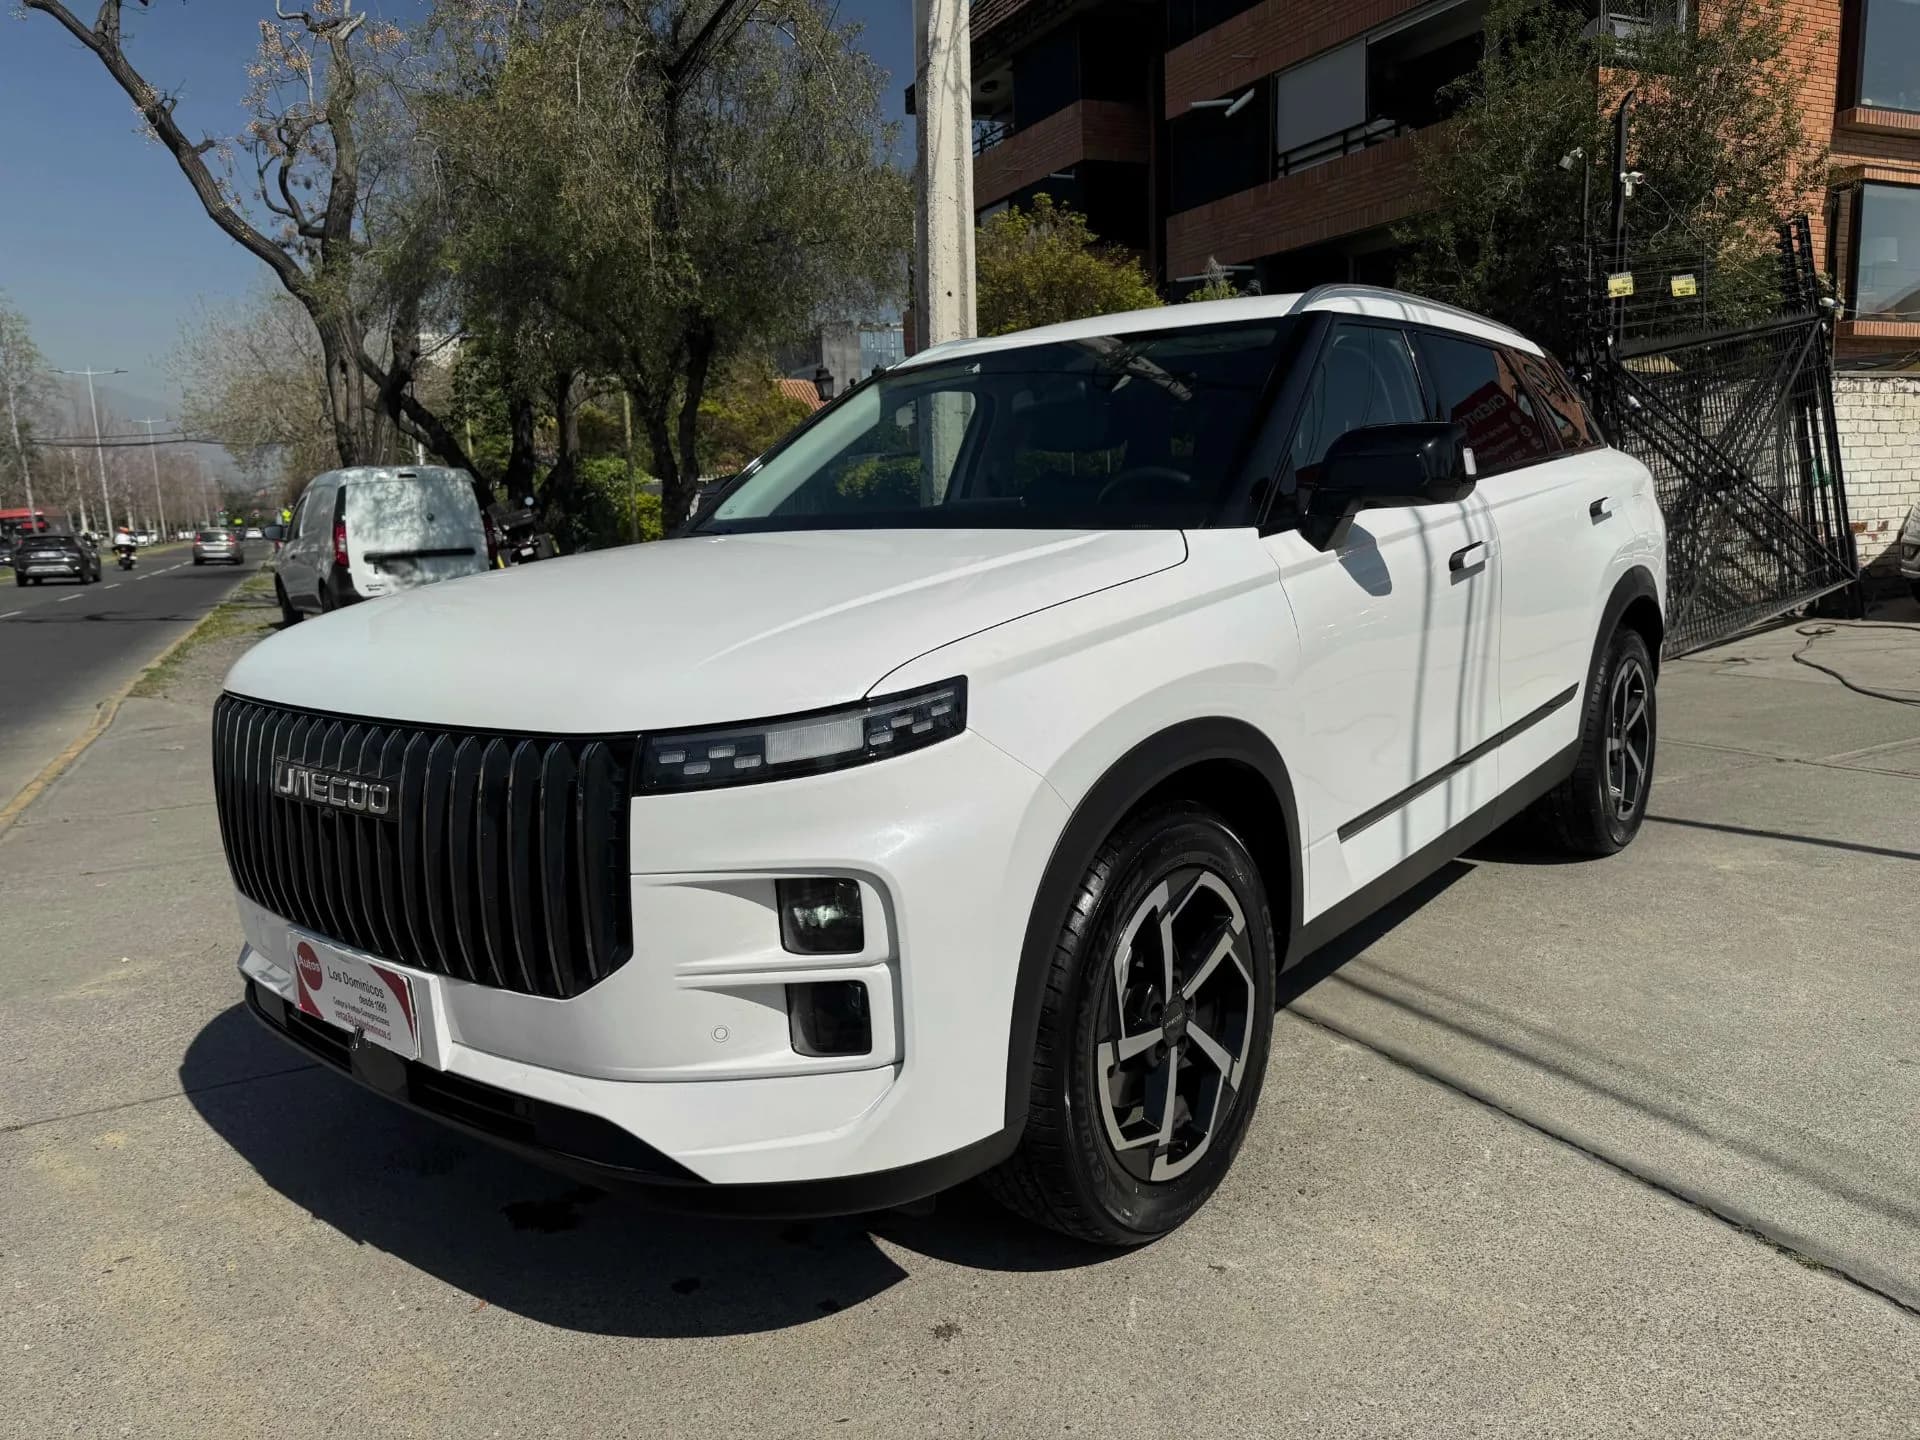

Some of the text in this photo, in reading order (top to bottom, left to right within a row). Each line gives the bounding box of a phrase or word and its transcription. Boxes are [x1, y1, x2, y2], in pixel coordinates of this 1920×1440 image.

[298, 954, 320, 972] Autos
[328, 966, 385, 998] Los Dominicos
